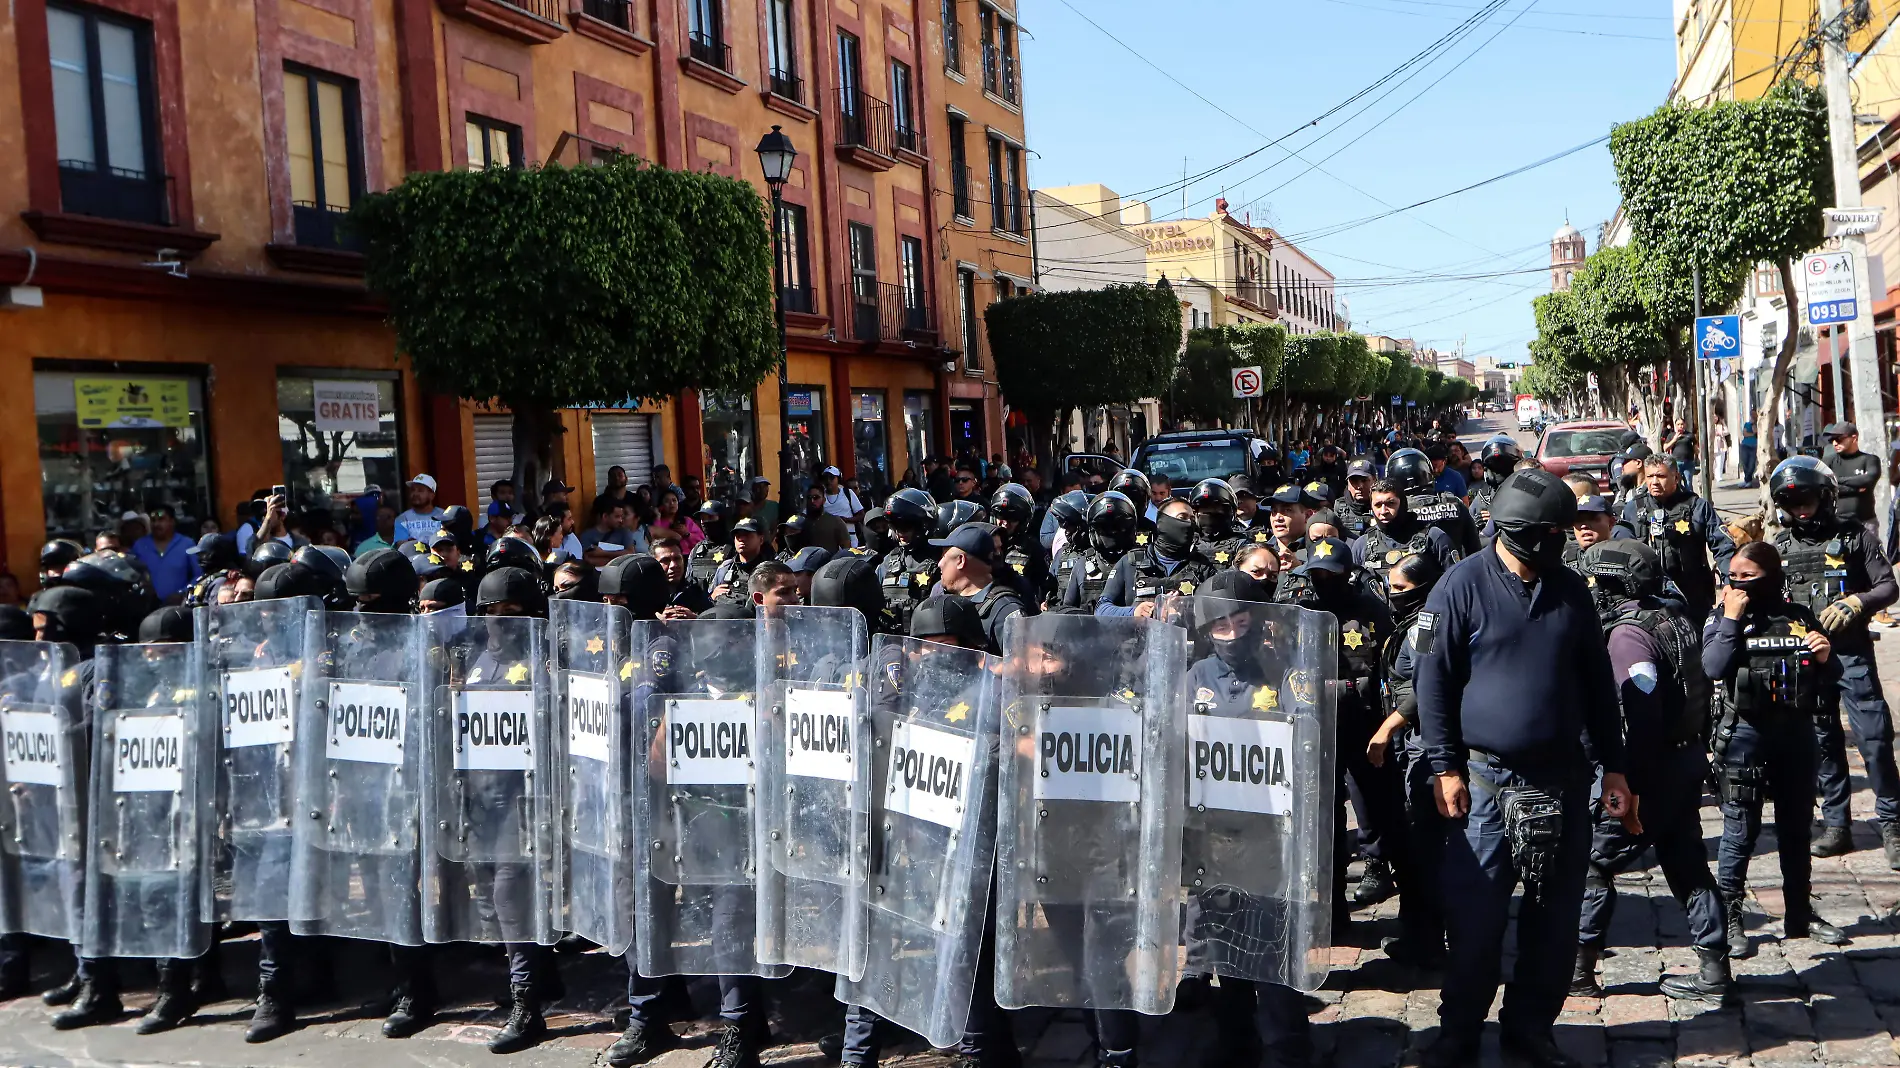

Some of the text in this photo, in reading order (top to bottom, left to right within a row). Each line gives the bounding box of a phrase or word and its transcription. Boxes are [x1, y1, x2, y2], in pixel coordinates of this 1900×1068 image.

[1133, 225, 1186, 239] HOTEL
[1845, 228, 1865, 236] GAS
[1811, 304, 1838, 320] 093
[319, 402, 377, 420] GRATIS
[1416, 511, 1459, 521] MUNICIPAL
[1747, 638, 1810, 649] POLICIA
[228, 688, 290, 724] POLICIA
[332, 703, 401, 740] POLICIA
[571, 697, 610, 738] POLICIA
[457, 711, 530, 746] POLICIA
[671, 721, 750, 759] POLICIA
[790, 712, 850, 754] POLICIA
[7, 731, 58, 763] POLICIA
[120, 738, 177, 769] POLICIA
[1041, 731, 1134, 774] POLICIA
[1195, 740, 1286, 786] POLICIA
[890, 746, 963, 801] POLICIA
